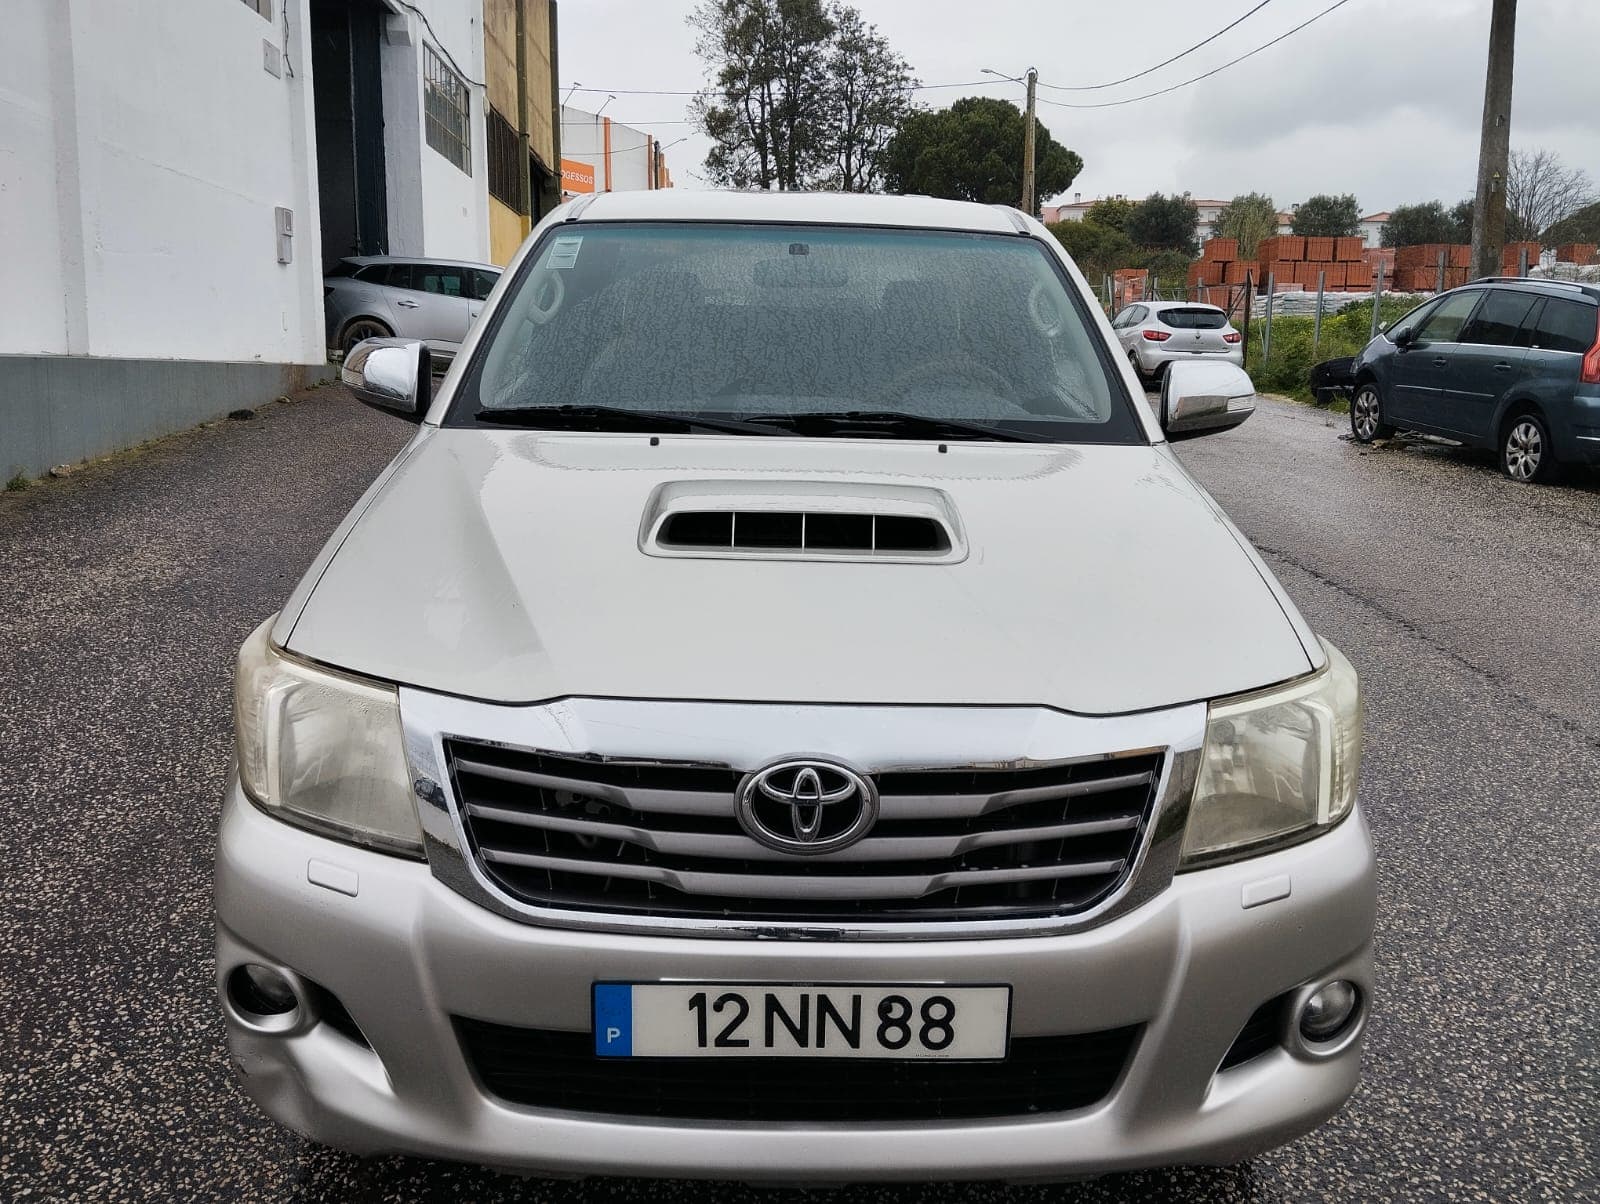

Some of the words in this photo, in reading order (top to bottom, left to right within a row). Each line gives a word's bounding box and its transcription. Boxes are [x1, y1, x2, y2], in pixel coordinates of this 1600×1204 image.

[607, 1027, 621, 1043] P
[688, 993, 750, 1048] 12
[764, 993, 862, 1049] NN
[876, 995, 956, 1050] 88
